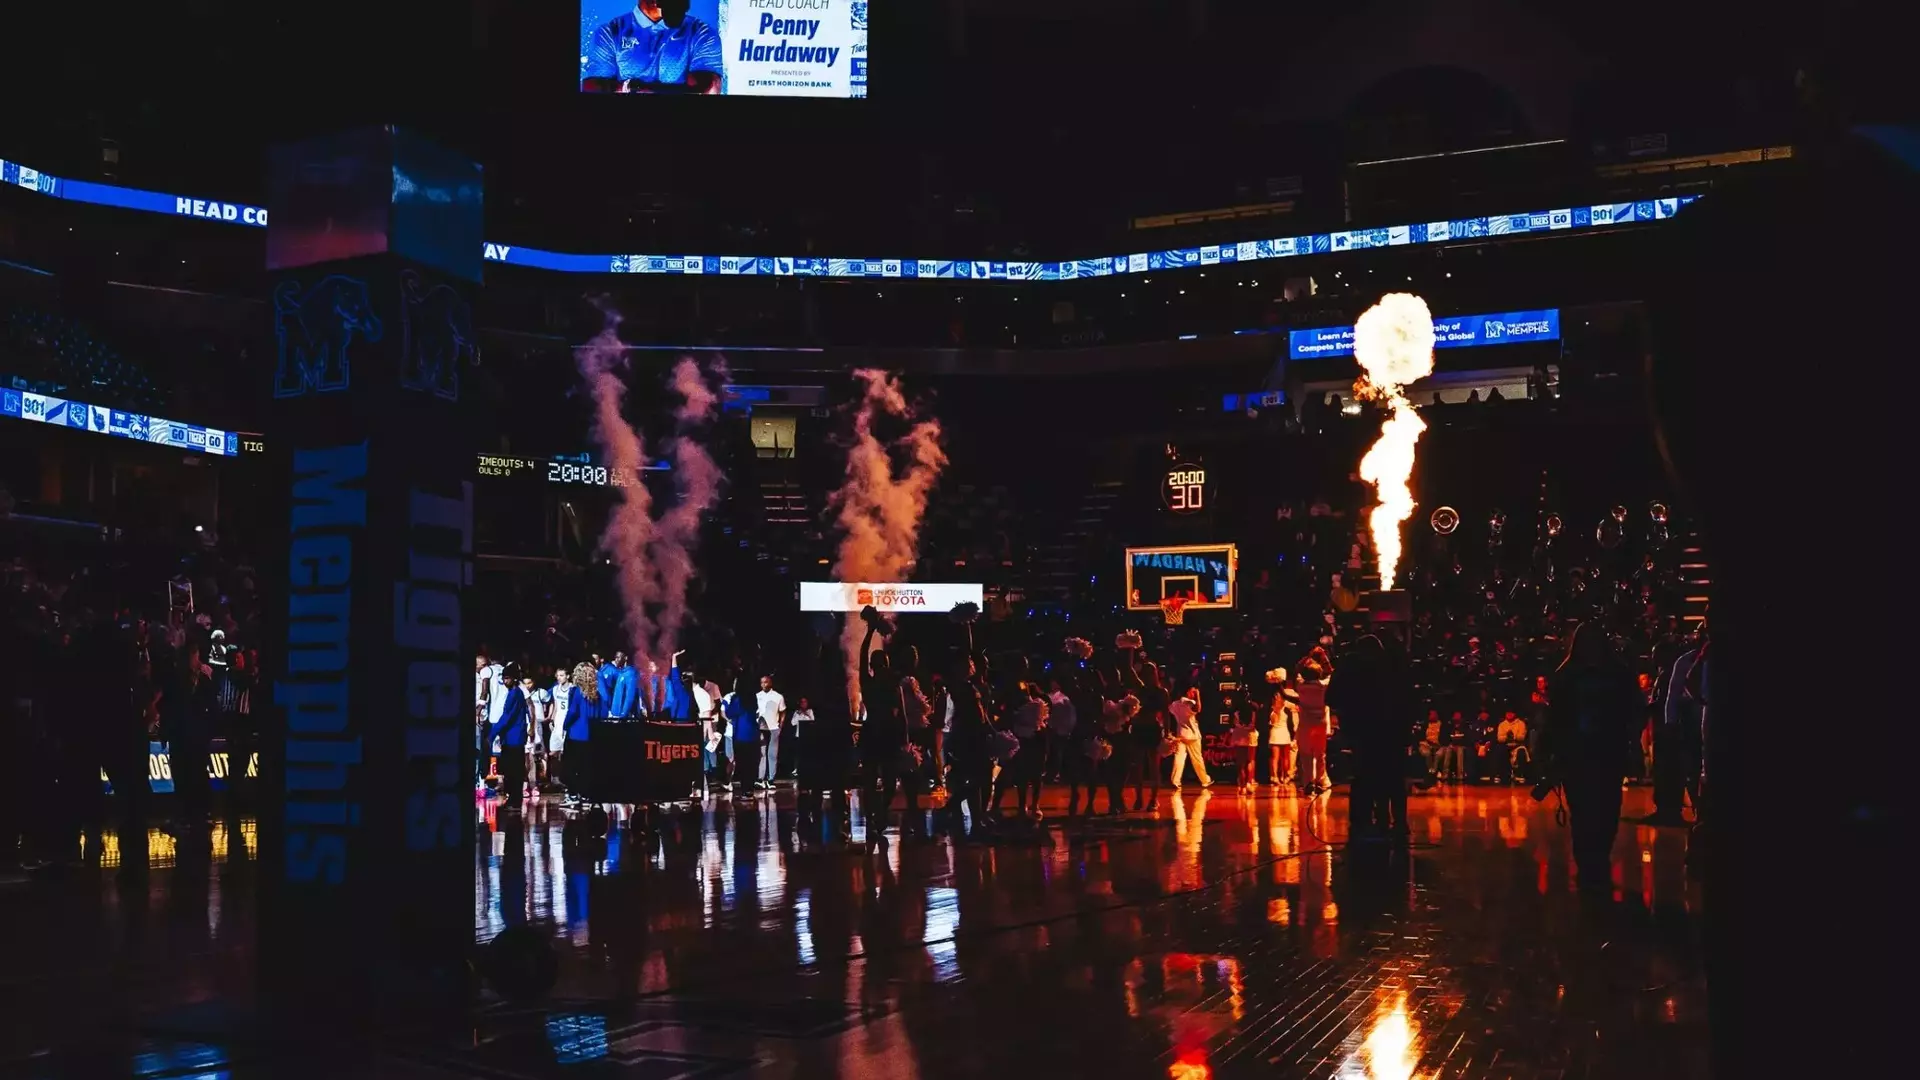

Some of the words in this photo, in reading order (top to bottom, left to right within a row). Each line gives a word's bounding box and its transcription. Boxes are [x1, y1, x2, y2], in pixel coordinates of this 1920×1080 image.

[749, 0, 784, 8] HEAD
[787, 0, 830, 9] COACH
[758, 12, 820, 40] Penny
[738, 39, 840, 67] Hardaway
[38, 173, 56, 193] 901
[176, 197, 237, 221] HEAD
[1592, 208, 1613, 221] 901
[1512, 218, 1526, 228] GO
[1553, 214, 1567, 223] GO
[1448, 221, 1468, 237] 901
[484, 243, 510, 260] AY
[1186, 252, 1199, 261] GO
[1222, 249, 1235, 257] GO
[651, 260, 663, 269] GO
[687, 260, 699, 269] GO
[721, 260, 738, 270] 901
[850, 264, 862, 272] GO
[885, 264, 897, 272] GO
[919, 264, 936, 274] 901
[1447, 332, 1475, 340] Global
[1506, 325, 1550, 335] MEMPHIS
[24, 397, 45, 416] 901
[171, 429, 184, 440] GO
[209, 436, 221, 447] GO
[243, 441, 264, 452] TIG
[478, 456, 524, 469] IMEOUTS:
[527, 461, 535, 469] 4
[548, 462, 607, 486] 20:00
[1168, 470, 1205, 485] 20:00
[1172, 485, 1203, 509] 30
[875, 596, 926, 606] TOYOTA
[273, 438, 369, 887] Memphis
[393, 480, 474, 852] Tigers
[644, 740, 700, 764] Tigers
